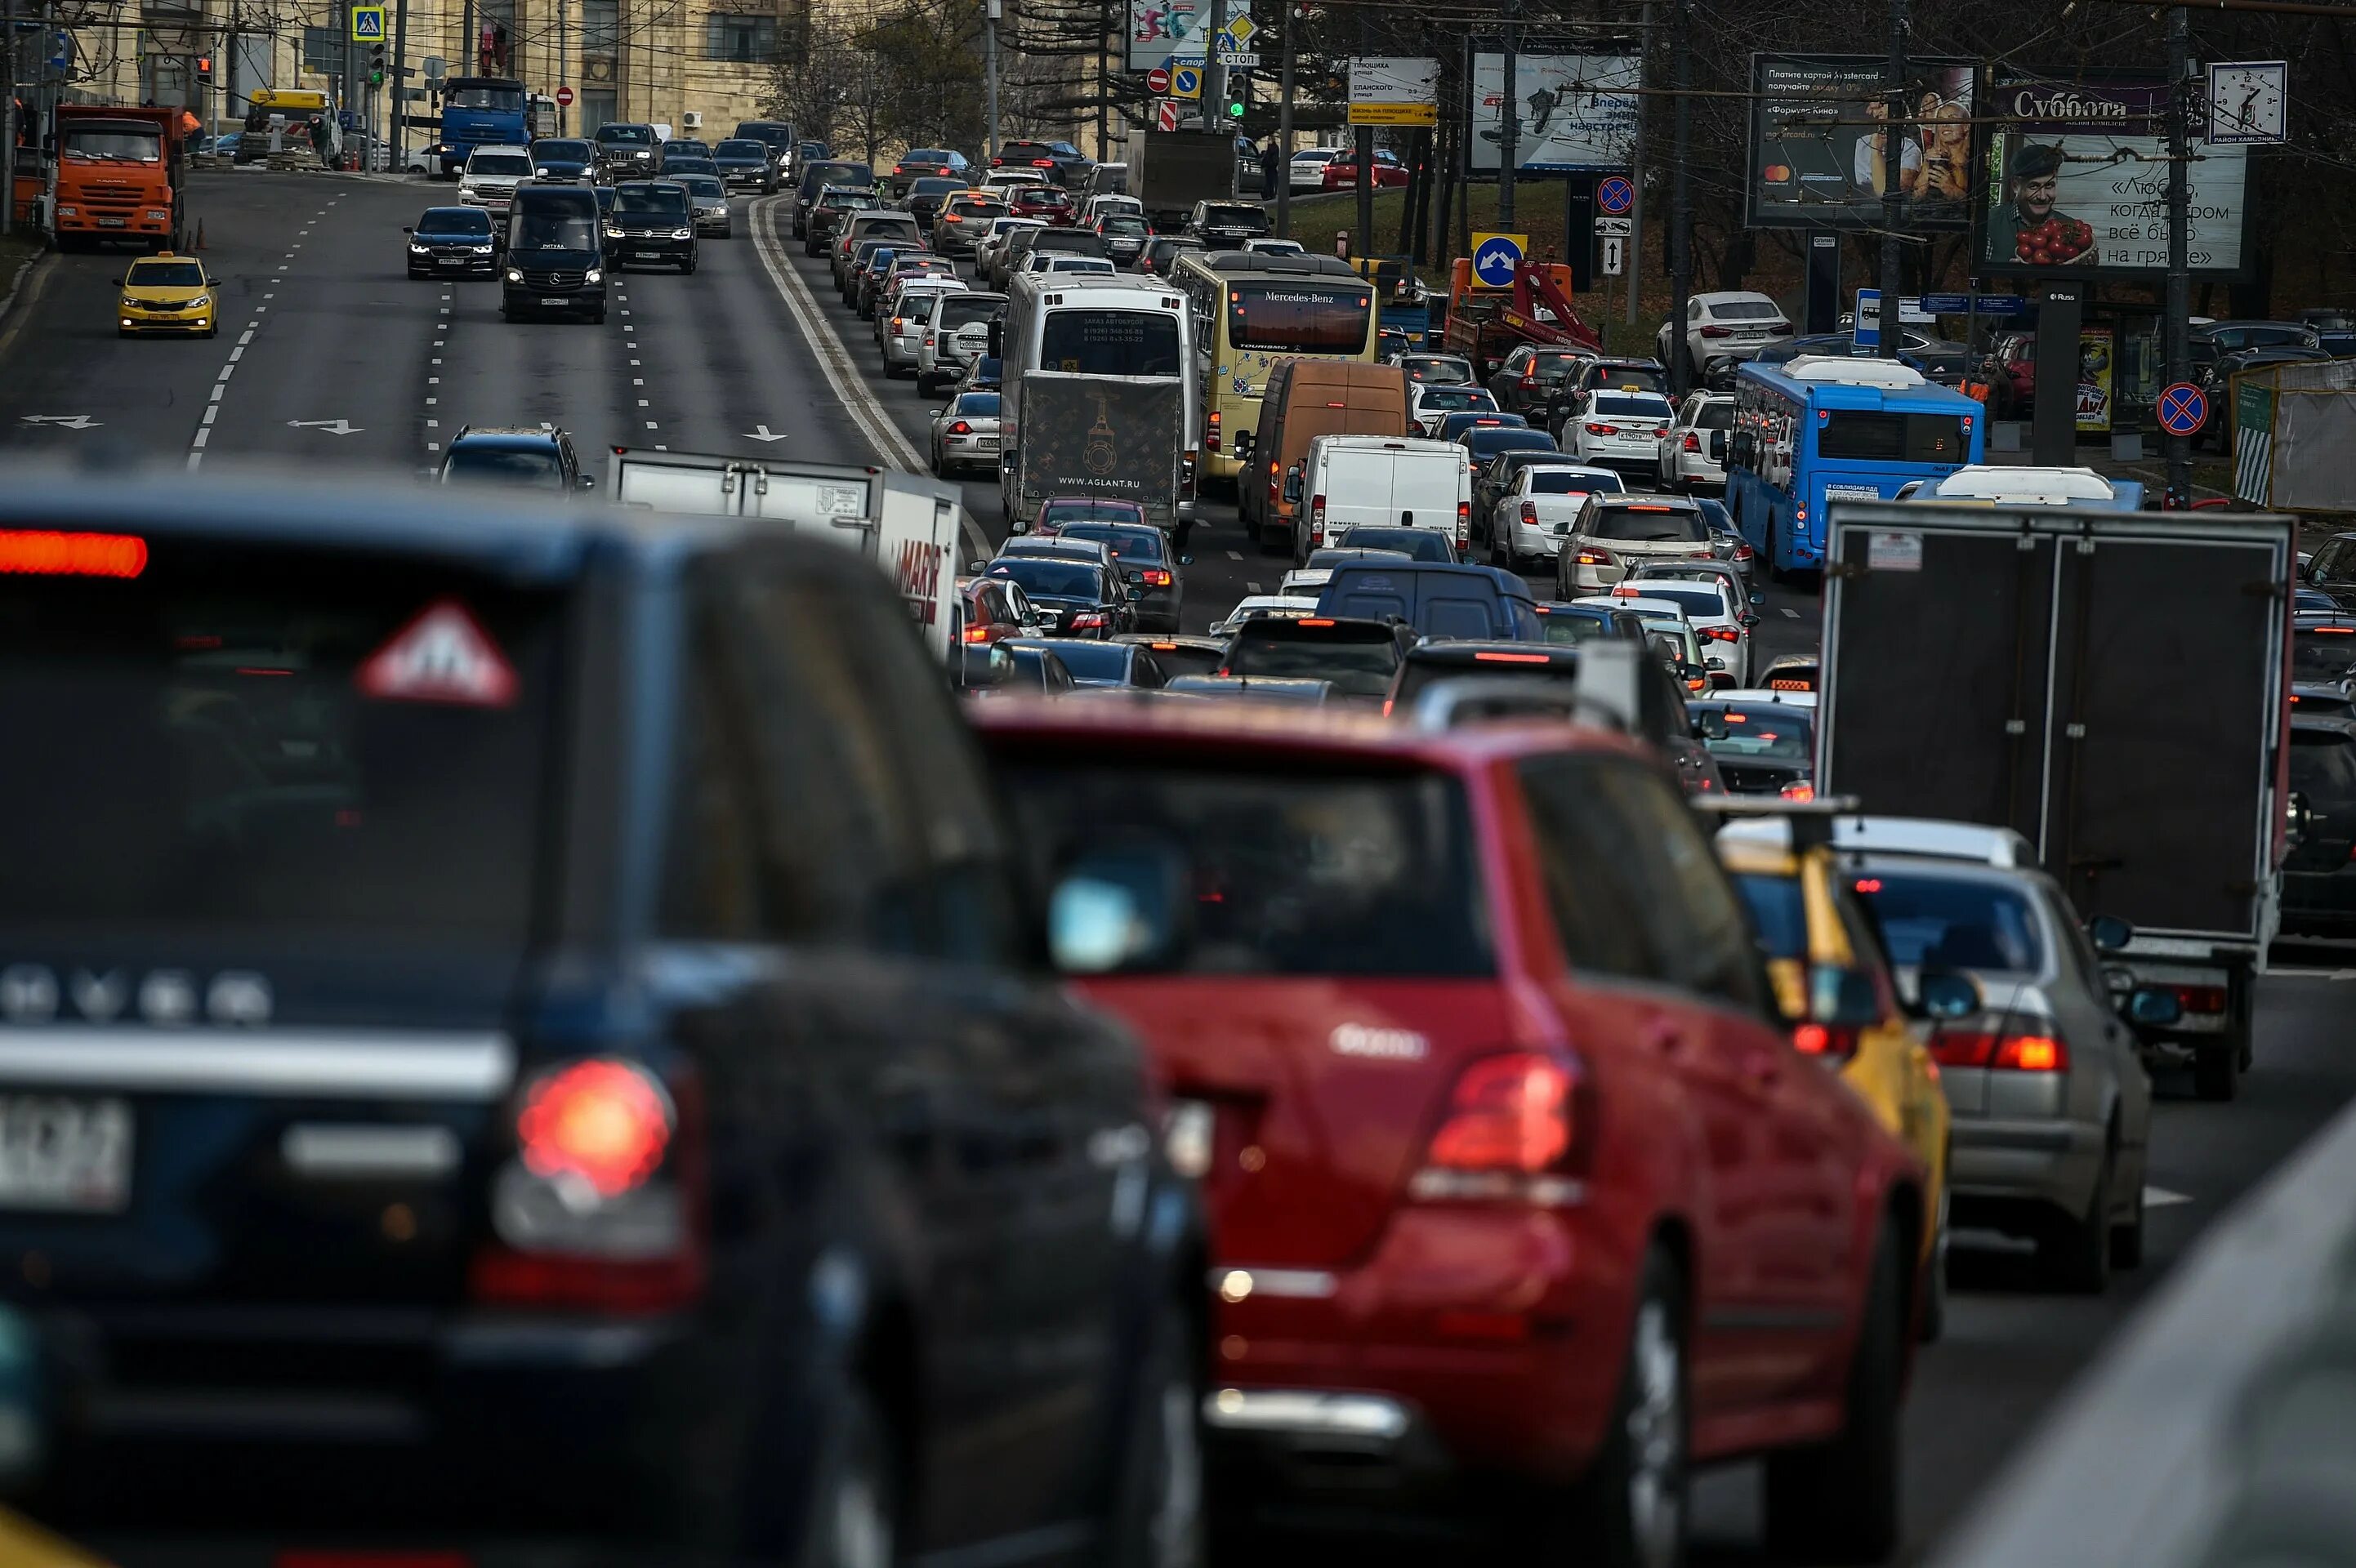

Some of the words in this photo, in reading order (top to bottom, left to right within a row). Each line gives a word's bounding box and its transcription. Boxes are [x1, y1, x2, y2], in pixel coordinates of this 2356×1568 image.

[1225, 54, 1254, 64] СТОП
[1769, 70, 1801, 78] Платите
[1804, 72, 1832, 80] картой
[1768, 83, 1810, 91] получайте
[2014, 91, 2126, 125] Суббота
[2110, 205, 2160, 220] когда
[2109, 224, 2140, 239] всё
[2108, 250, 2129, 263] на
[1265, 292, 1334, 304] Mercedes-Benz
[1059, 477, 1140, 488] WWW.AGLANT.RU
